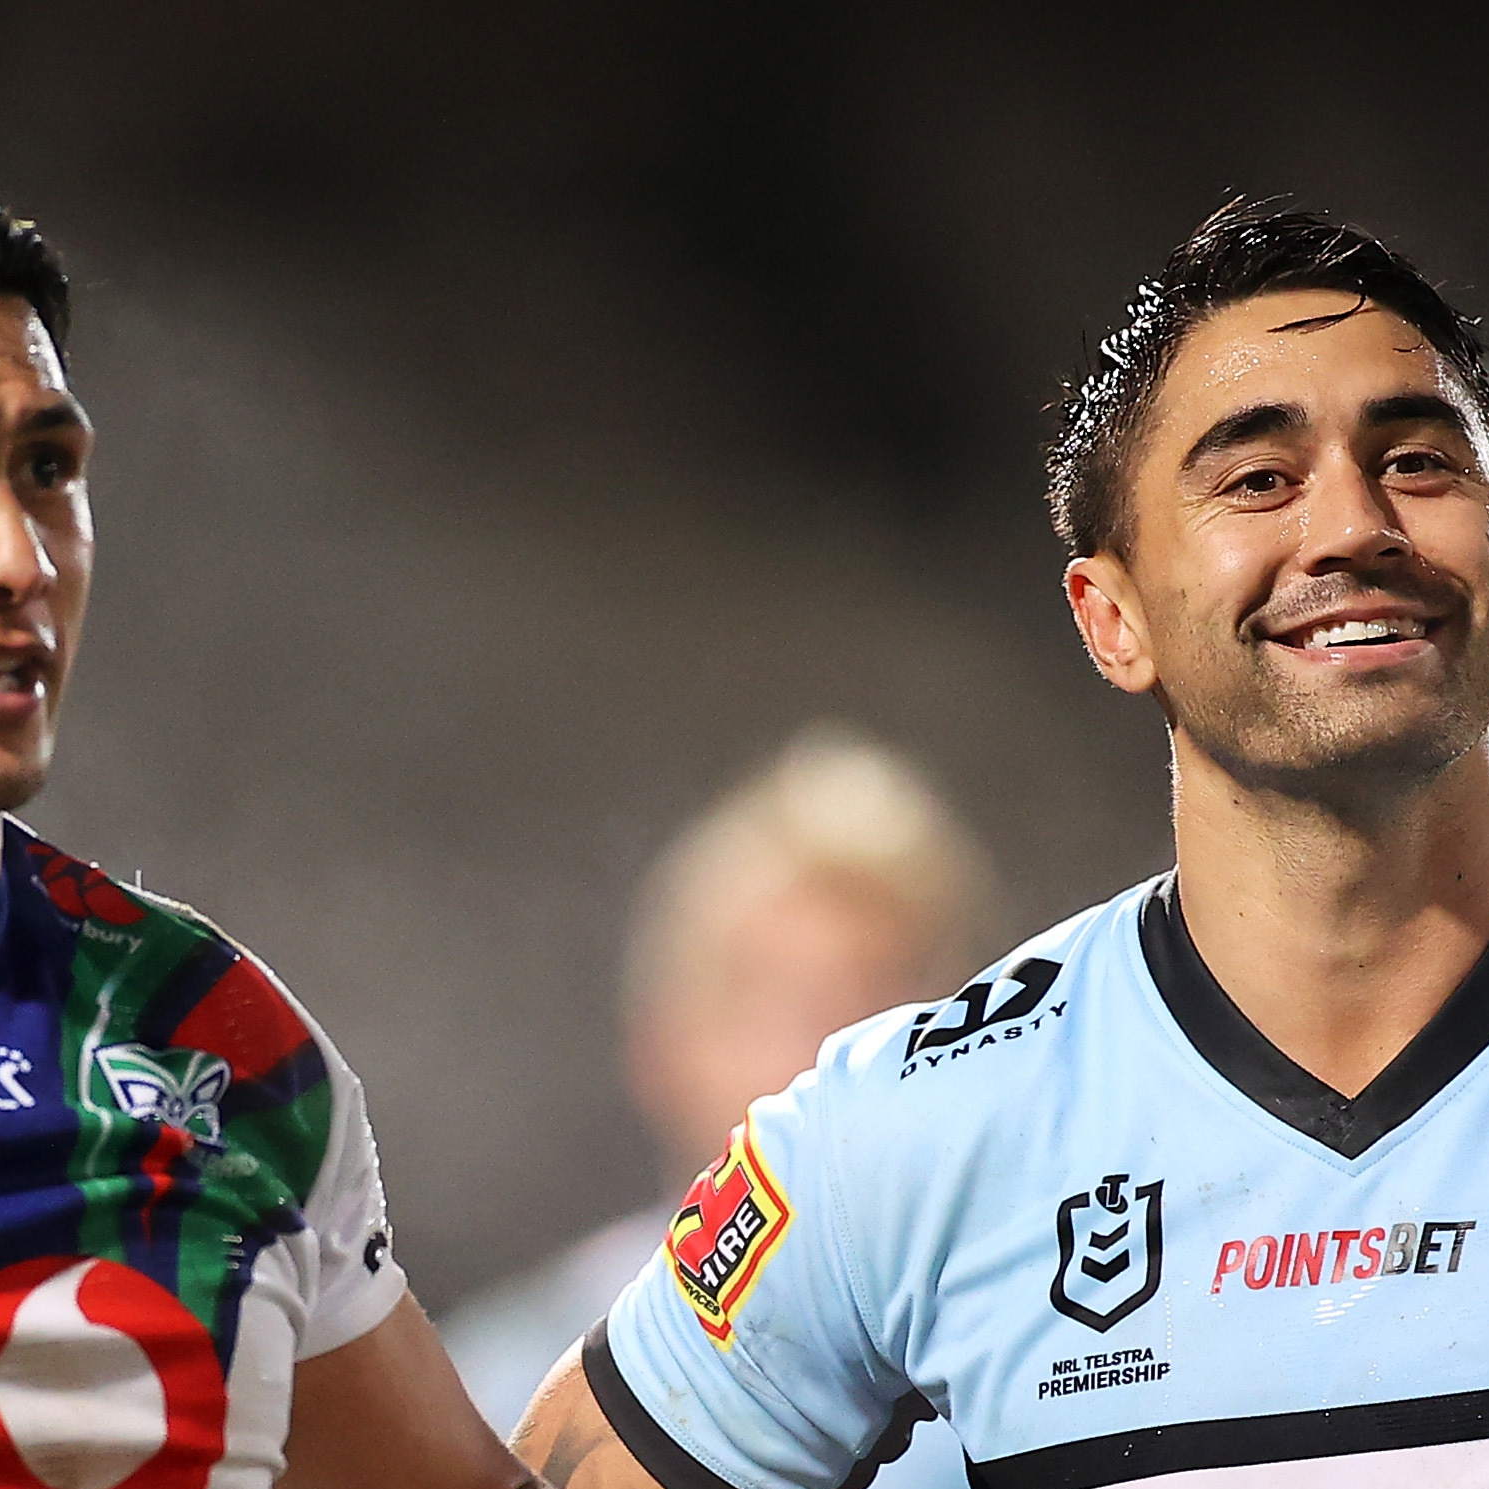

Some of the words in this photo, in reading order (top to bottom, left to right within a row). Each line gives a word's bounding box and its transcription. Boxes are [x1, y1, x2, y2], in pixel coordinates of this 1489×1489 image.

[900, 1001, 1068, 1080] DYNASTY
[700, 1201, 761, 1288] HIRE
[1211, 1220, 1477, 1294] POINTSBET
[1039, 1362, 1171, 1400] PREMIERSHIP
[1052, 1358, 1081, 1376] NRL
[1084, 1347, 1154, 1370] TELSTRA
